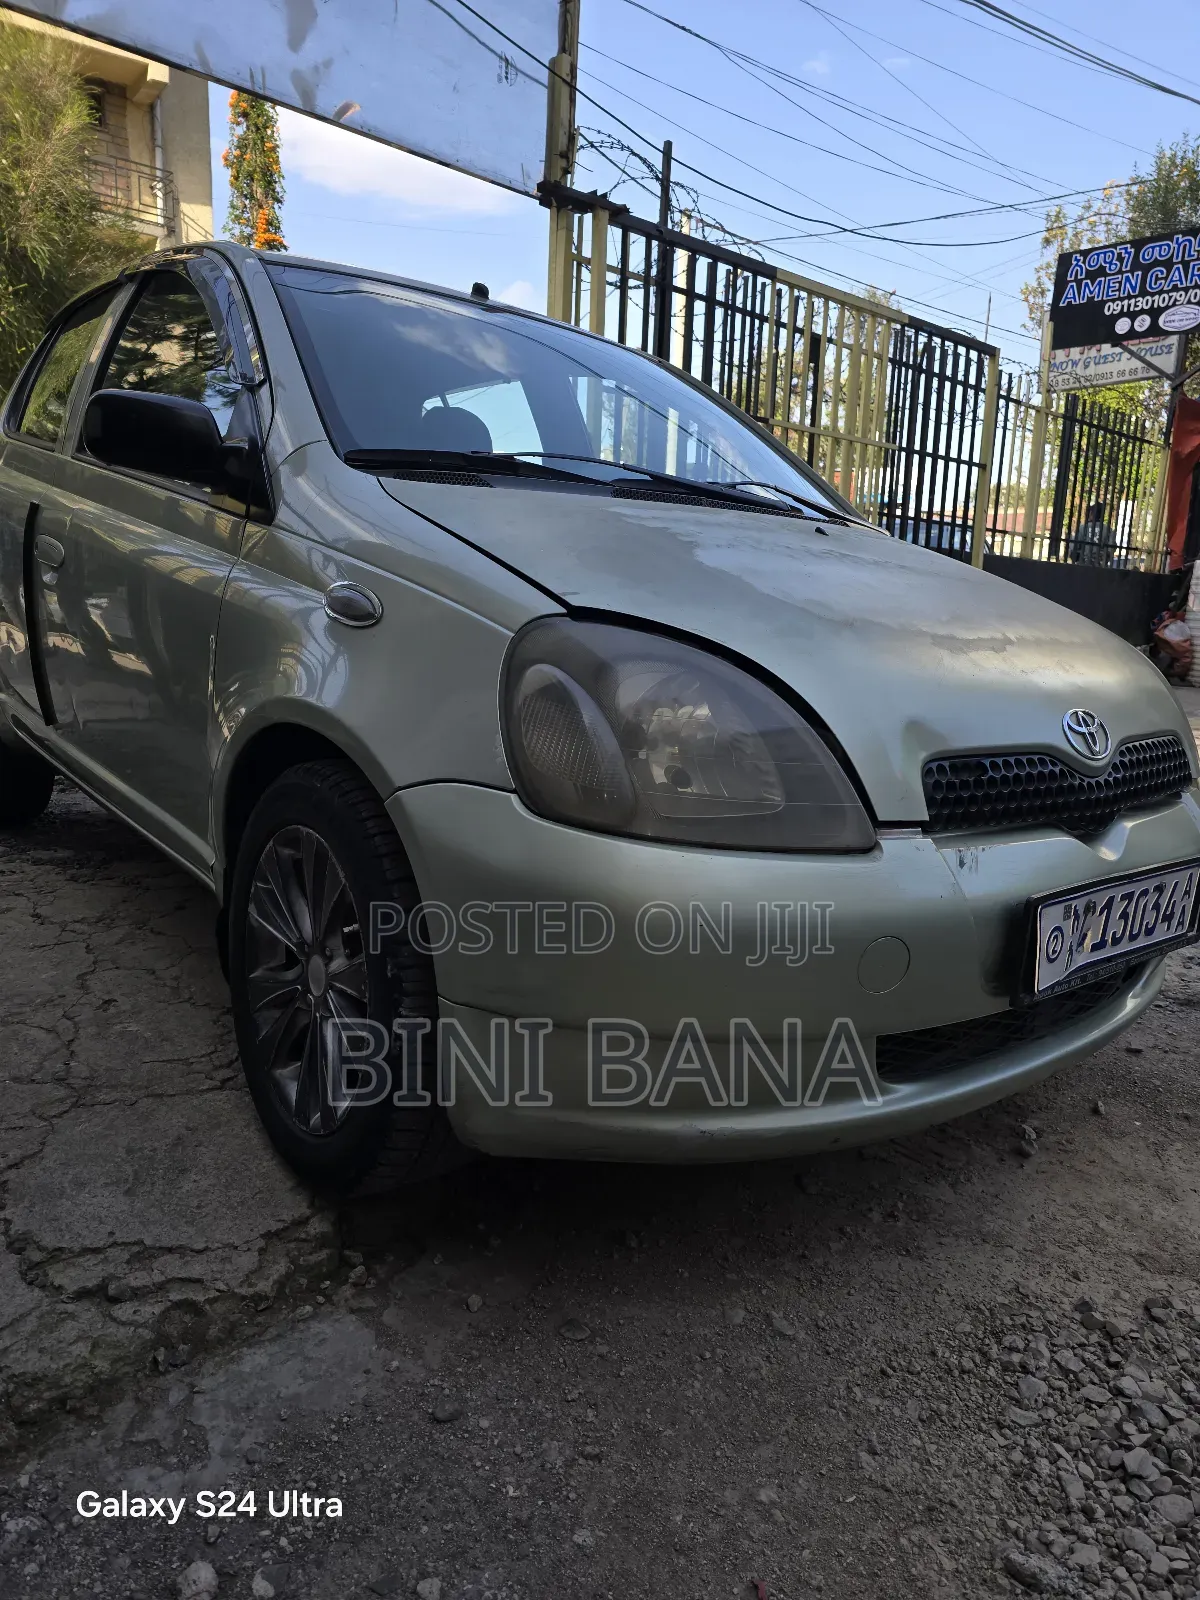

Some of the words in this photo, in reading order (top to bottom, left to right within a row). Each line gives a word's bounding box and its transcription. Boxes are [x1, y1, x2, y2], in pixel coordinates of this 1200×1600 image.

[1067, 245, 1134, 280] አሜን
[1059, 271, 1142, 306] AMEN
[1083, 352, 1125, 369] GUEST
[1181, 872, 1193, 903] A
[1173, 904, 1186, 934] A
